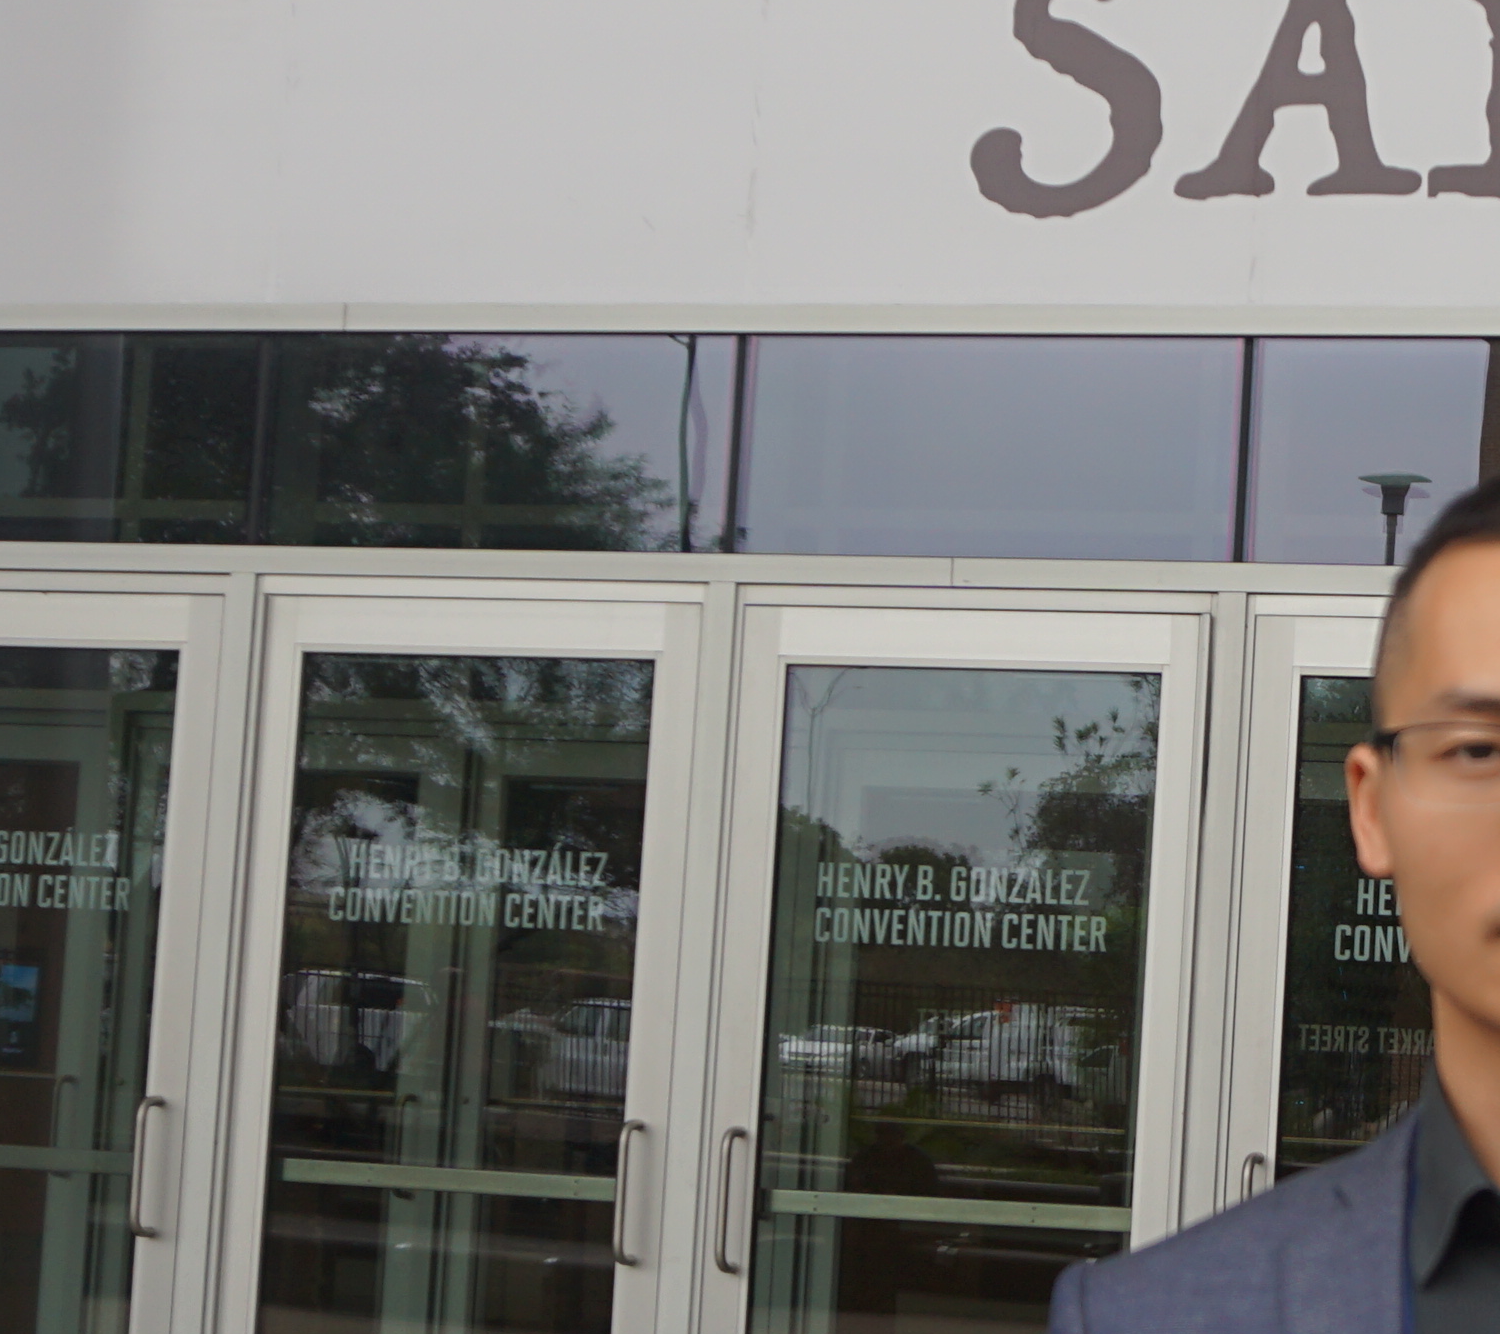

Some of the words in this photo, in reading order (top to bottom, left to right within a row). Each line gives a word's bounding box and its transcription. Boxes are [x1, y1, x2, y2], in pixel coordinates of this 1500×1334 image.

[36, 874, 130, 911] CENTER
[817, 861, 910, 900] HENRY
[916, 865, 941, 901] B.
[328, 886, 496, 926] CONVENTION
[504, 893, 605, 931] CENTER
[814, 907, 994, 948] CONVENTION
[1002, 913, 1107, 953] CENTER
